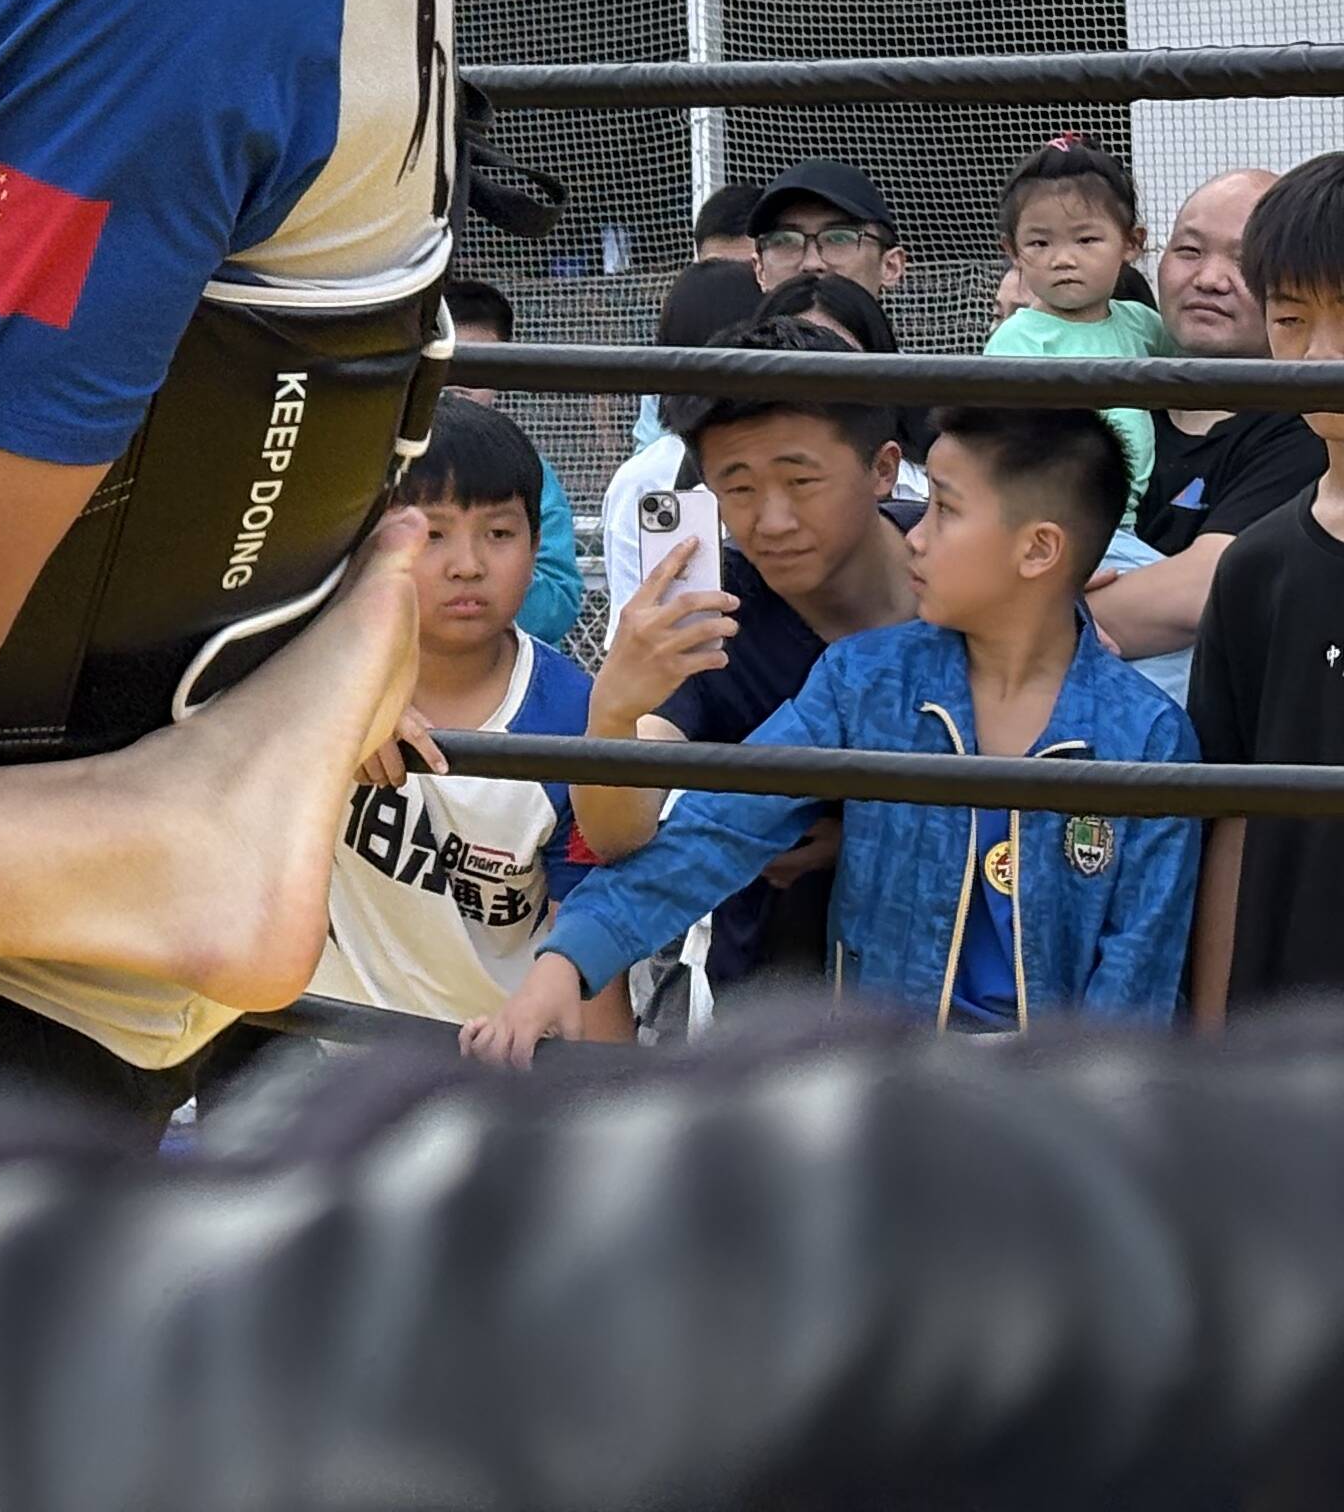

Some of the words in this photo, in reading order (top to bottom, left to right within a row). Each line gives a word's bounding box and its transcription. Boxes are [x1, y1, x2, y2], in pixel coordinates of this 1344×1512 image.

[262, 372, 308, 472] KEEP
[222, 480, 283, 590] DOING
[467, 855, 503, 874] FIGHT
